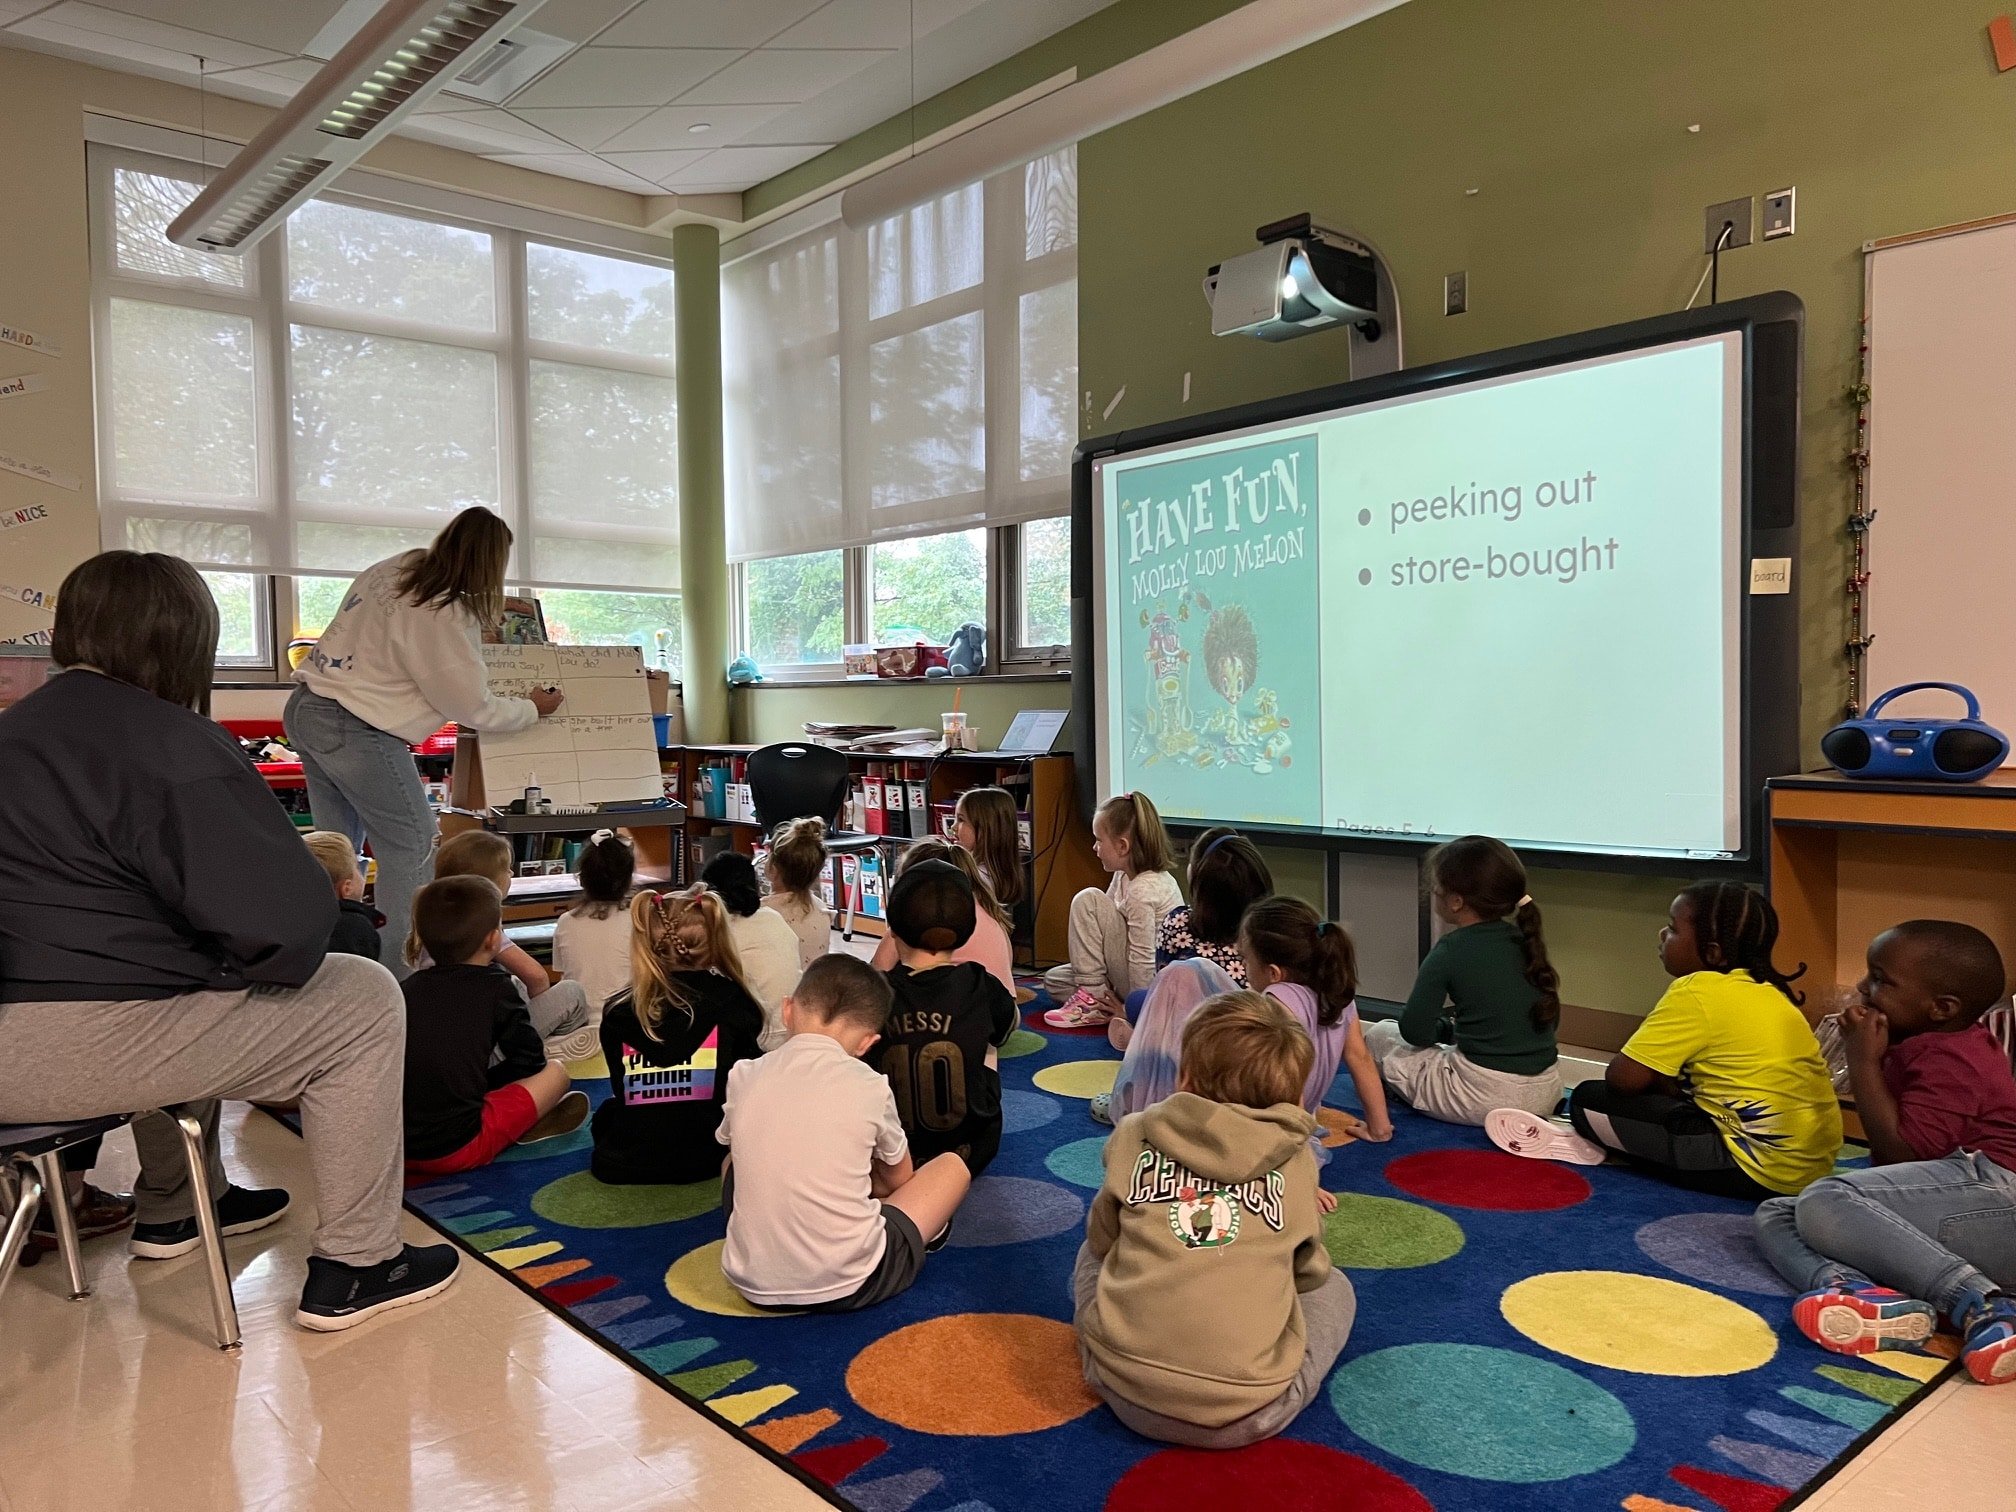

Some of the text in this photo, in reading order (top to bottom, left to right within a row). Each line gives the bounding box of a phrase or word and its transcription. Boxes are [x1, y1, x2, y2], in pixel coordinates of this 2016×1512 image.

[2, 328, 34, 345] HARD
[1126, 452, 1307, 565] HAVE FUN,
[1391, 470, 1597, 534] peeking out
[15, 504, 48, 524] NICE
[1132, 526, 1305, 605] MOLLY LOU MELON
[1391, 536, 1619, 587] store-bought
[1753, 562, 1786, 584] board
[21, 588, 56, 610] CAN
[503, 645, 523, 657] did
[560, 656, 578, 666] Lou
[591, 647, 611, 658] did
[618, 715, 634, 725] her
[886, 1011, 953, 1040] MESSI
[882, 1040, 968, 1133] 10
[1169, 1201, 1185, 1237] BOSTO
